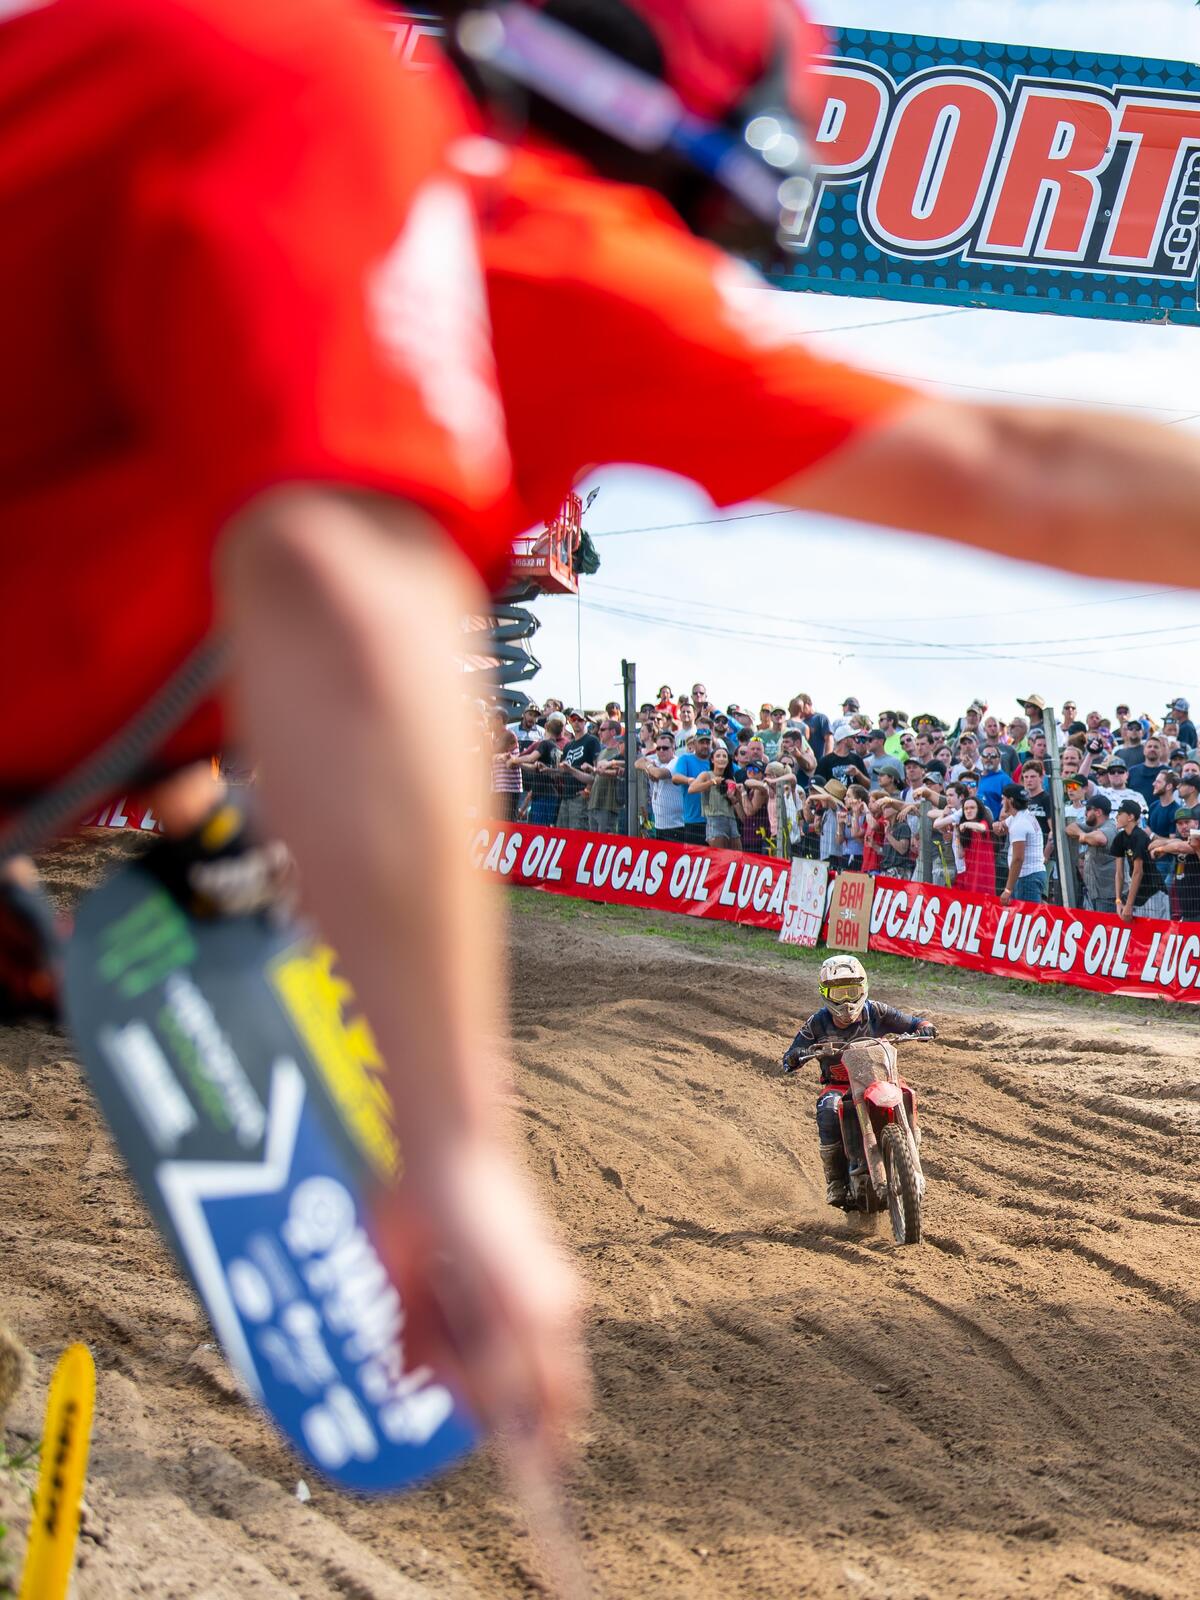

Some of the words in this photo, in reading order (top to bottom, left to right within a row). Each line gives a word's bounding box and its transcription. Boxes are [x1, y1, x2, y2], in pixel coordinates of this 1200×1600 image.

[468, 829, 523, 876] CAS
[521, 835, 567, 881] OIL
[575, 842, 668, 896] LUCAS
[668, 854, 711, 902] OIL
[719, 862, 789, 915] LUCA
[869, 887, 941, 945] UCAS
[941, 900, 983, 954] OIL
[991, 910, 1084, 972] LUCAS
[1083, 923, 1131, 978] OIL
[839, 881, 865, 911] BAM
[835, 919, 860, 947] BAM
